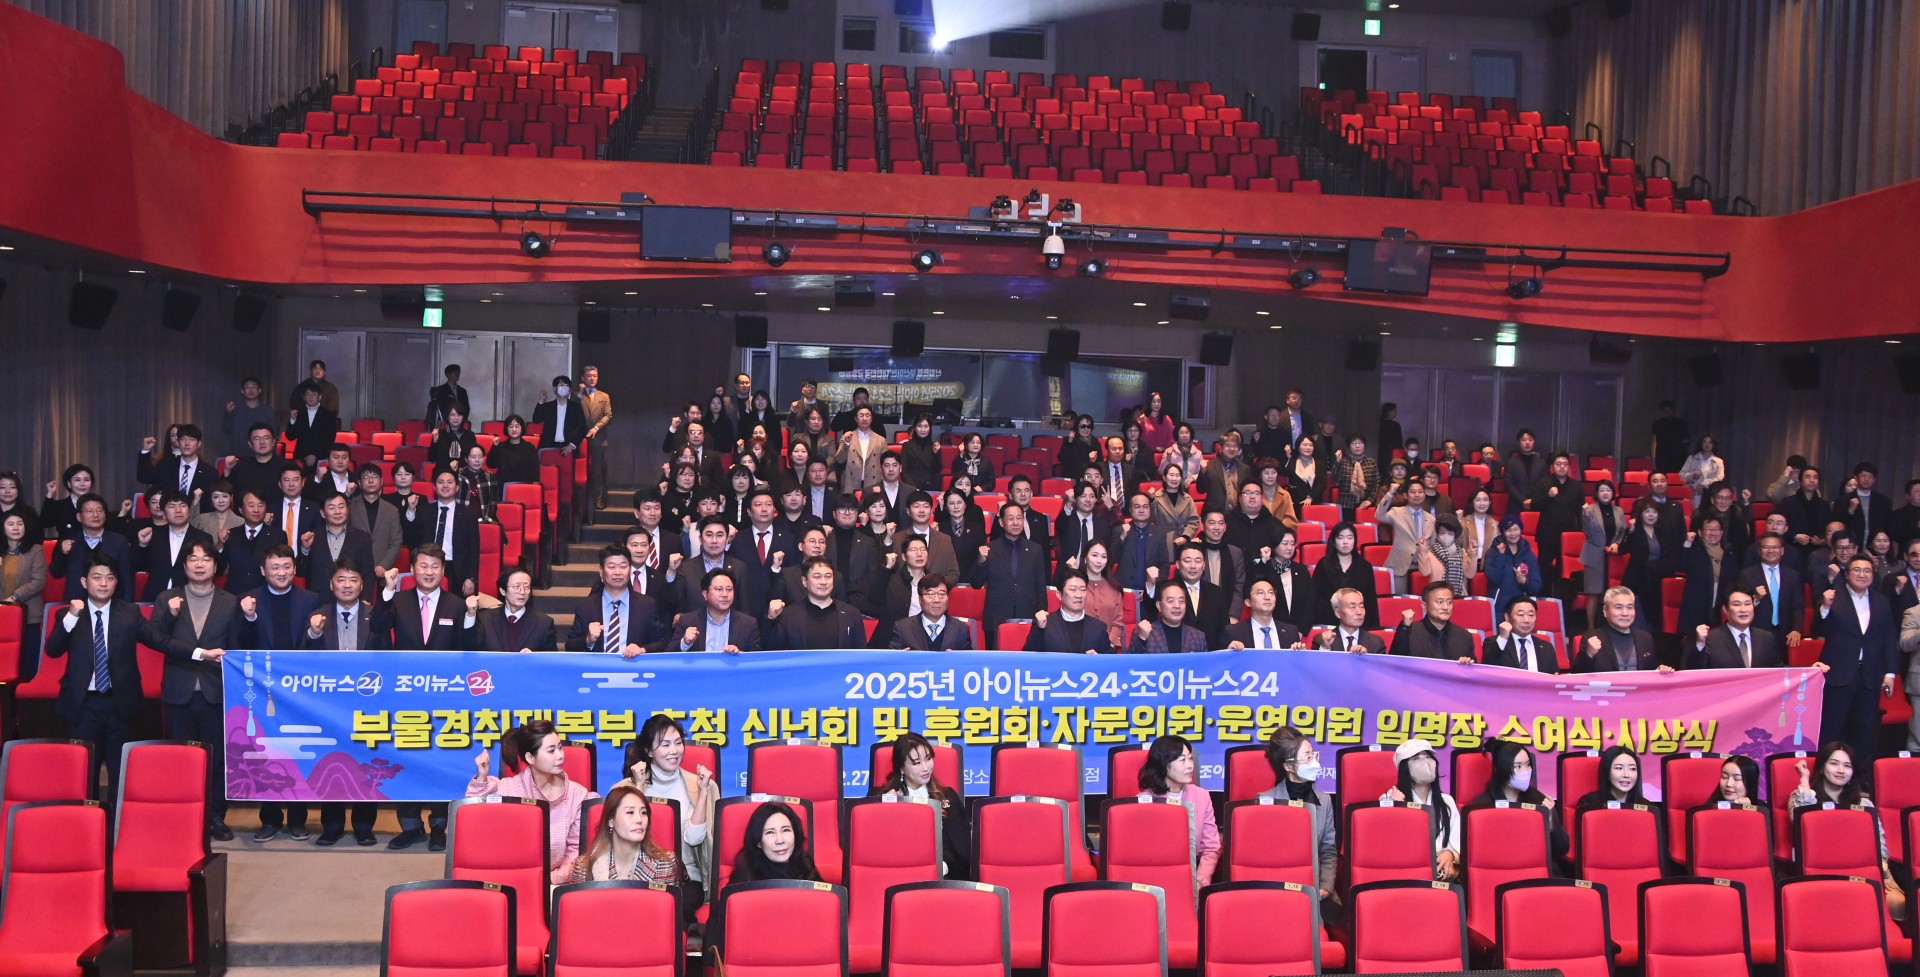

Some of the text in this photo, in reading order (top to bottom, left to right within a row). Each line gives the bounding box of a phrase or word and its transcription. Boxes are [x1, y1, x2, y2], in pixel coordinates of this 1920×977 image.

[281, 670, 495, 696] 아이뉴스24 조이뉴스24
[845, 667, 1279, 702] 2025년 아이뉴스24·조이뉴스24
[651, 708, 730, 746] 청
[741, 707, 858, 745] 신년회
[1375, 709, 1487, 748] 임명장
